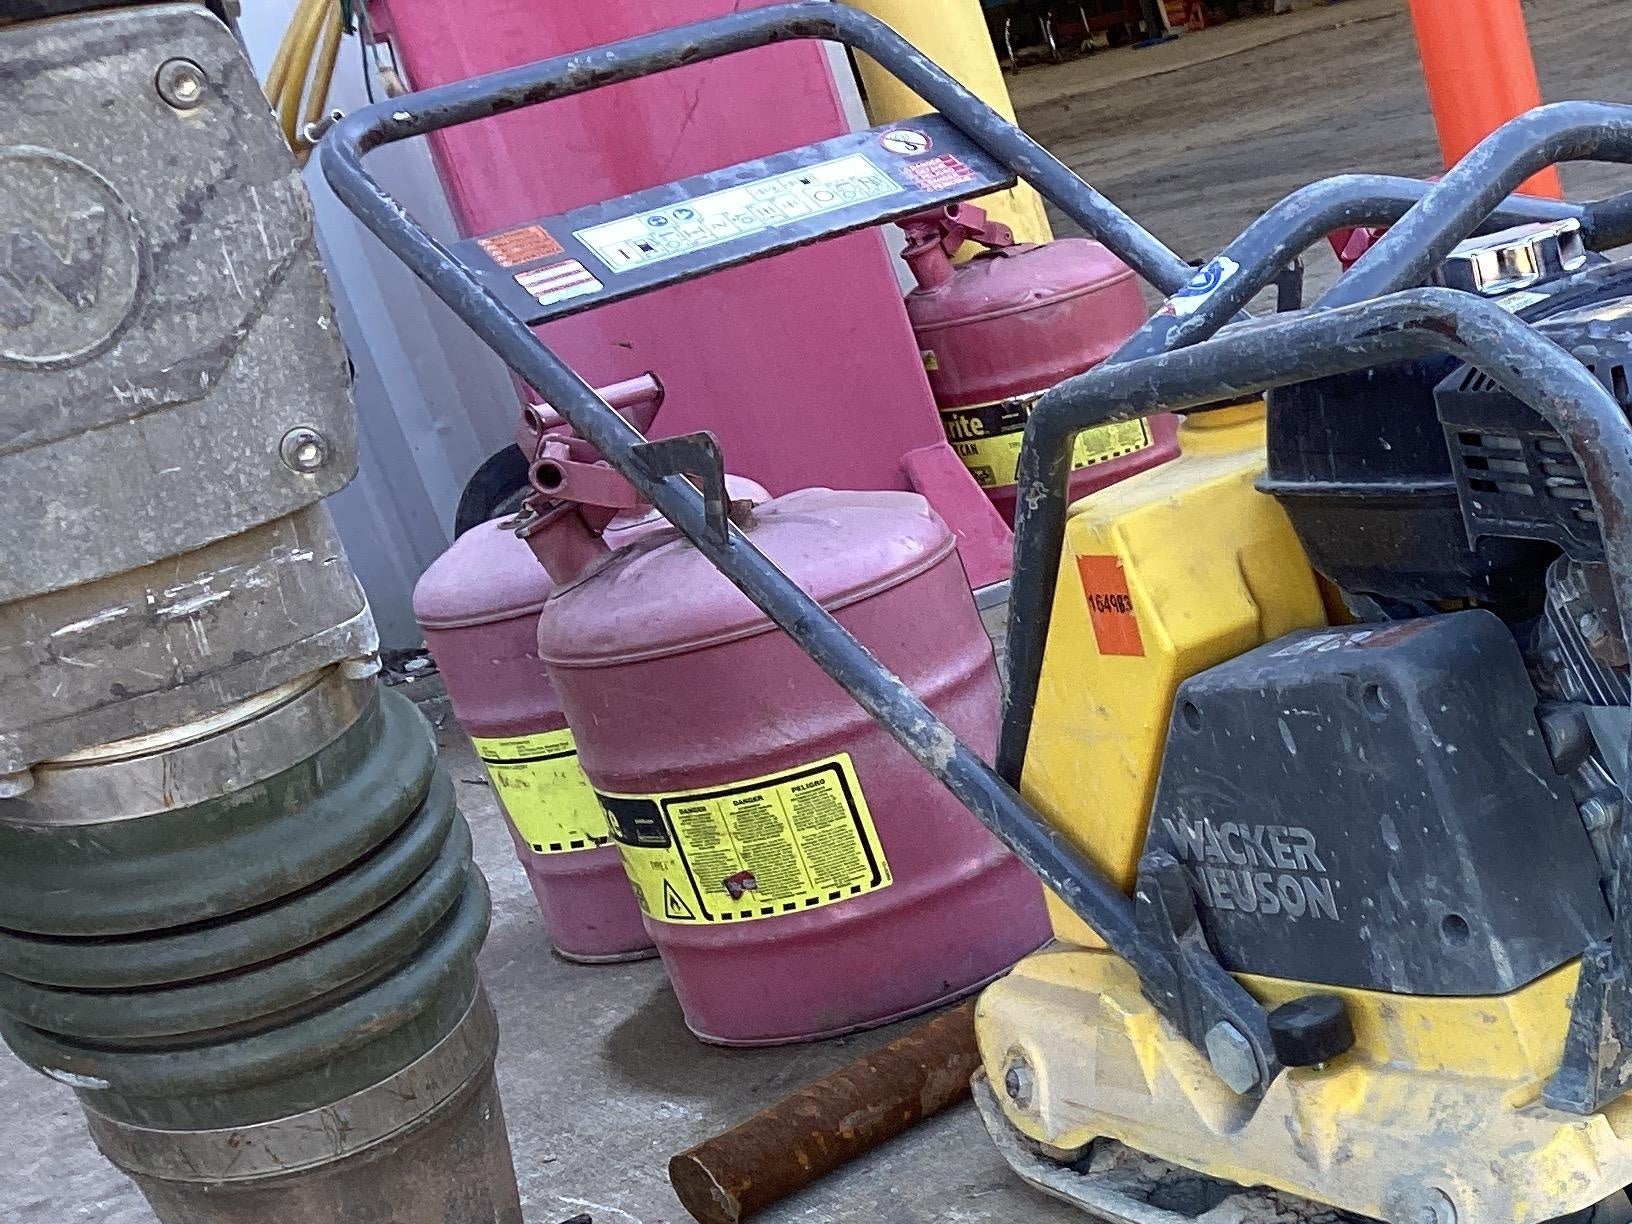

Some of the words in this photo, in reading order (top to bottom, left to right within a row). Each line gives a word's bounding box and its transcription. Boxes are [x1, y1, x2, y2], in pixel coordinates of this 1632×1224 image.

[948, 413, 985, 439] rite
[1088, 594, 1133, 614] 164903
[791, 778, 826, 793] PELIGRO
[732, 795, 764, 807] DANGER
[1162, 817, 1327, 872] WACKER
